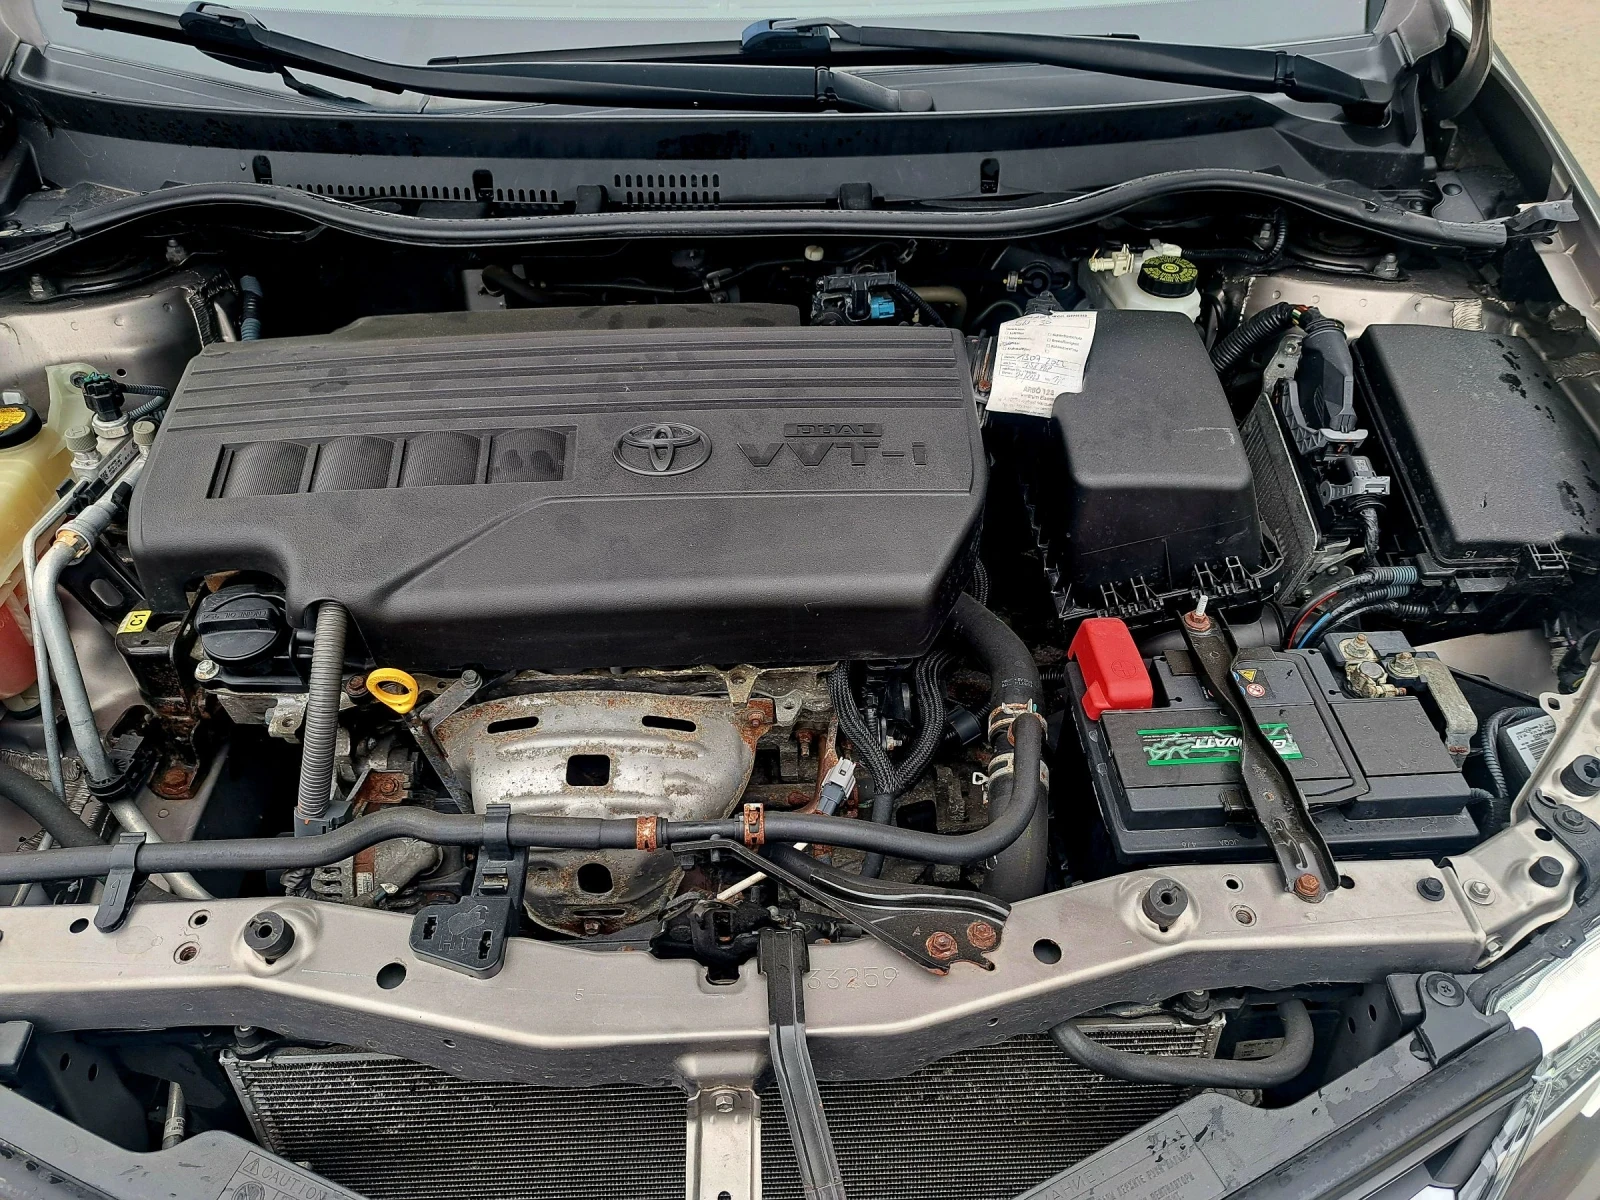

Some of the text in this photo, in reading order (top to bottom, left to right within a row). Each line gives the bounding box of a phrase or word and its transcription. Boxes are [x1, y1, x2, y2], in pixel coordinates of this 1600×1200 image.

[796, 424, 875, 435] DUAL
[736, 441, 927, 467] VVT-i
[129, 613, 146, 626] C1
[805, 965, 900, 990] 33259
[261, 1165, 328, 1200] CAUTION
